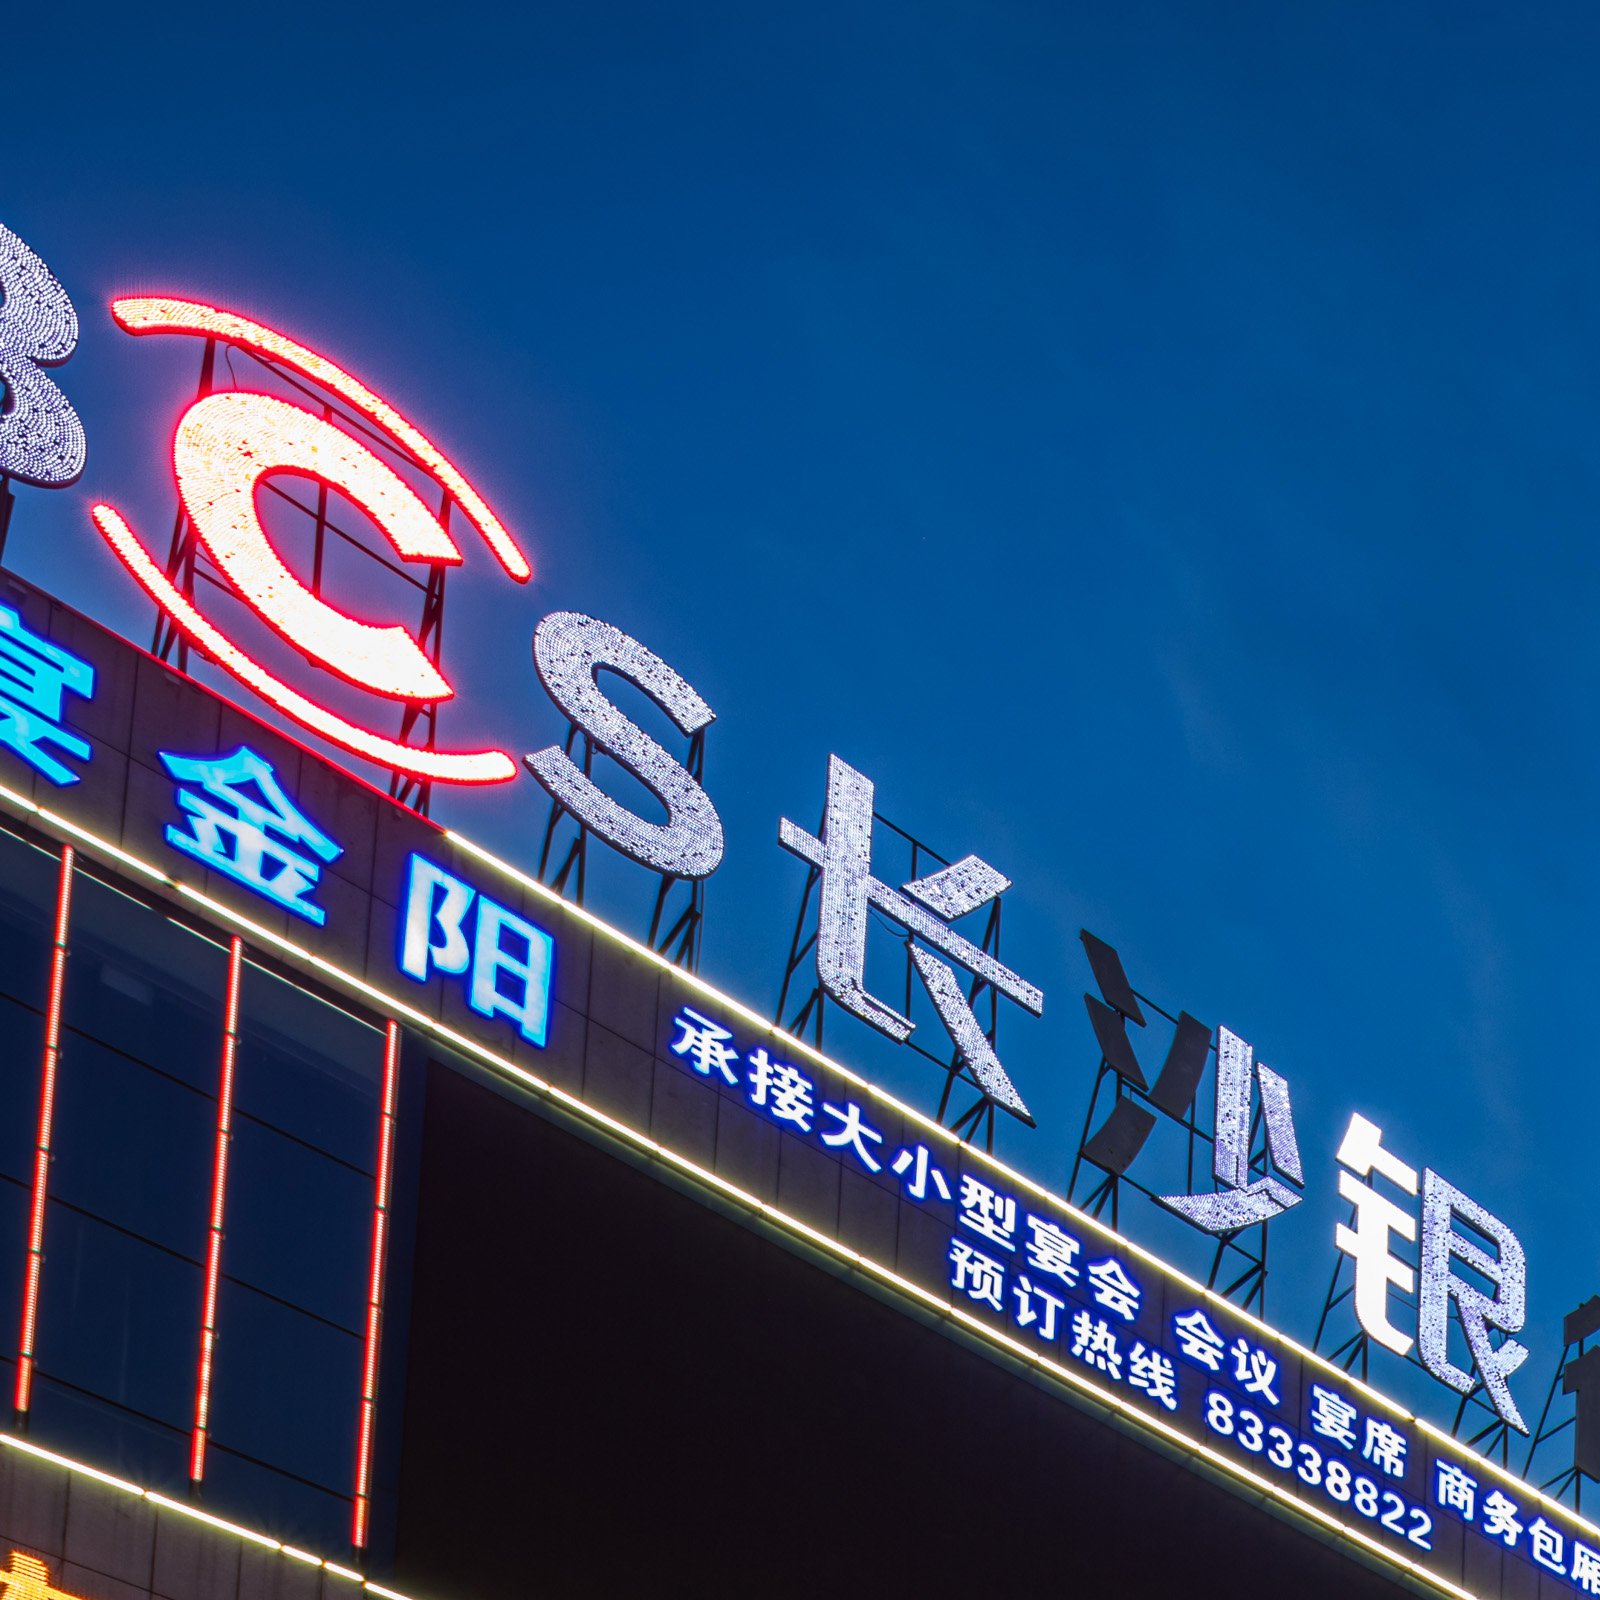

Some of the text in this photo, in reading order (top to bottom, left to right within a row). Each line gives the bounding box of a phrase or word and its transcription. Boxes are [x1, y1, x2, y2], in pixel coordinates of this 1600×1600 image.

[671, 1005, 1142, 1322] 承接大小型宴会
[1174, 1308, 1281, 1406] 会议
[1310, 1383, 1408, 1479] 宴席
[947, 1236, 1434, 1551] 预订热线 83338822
